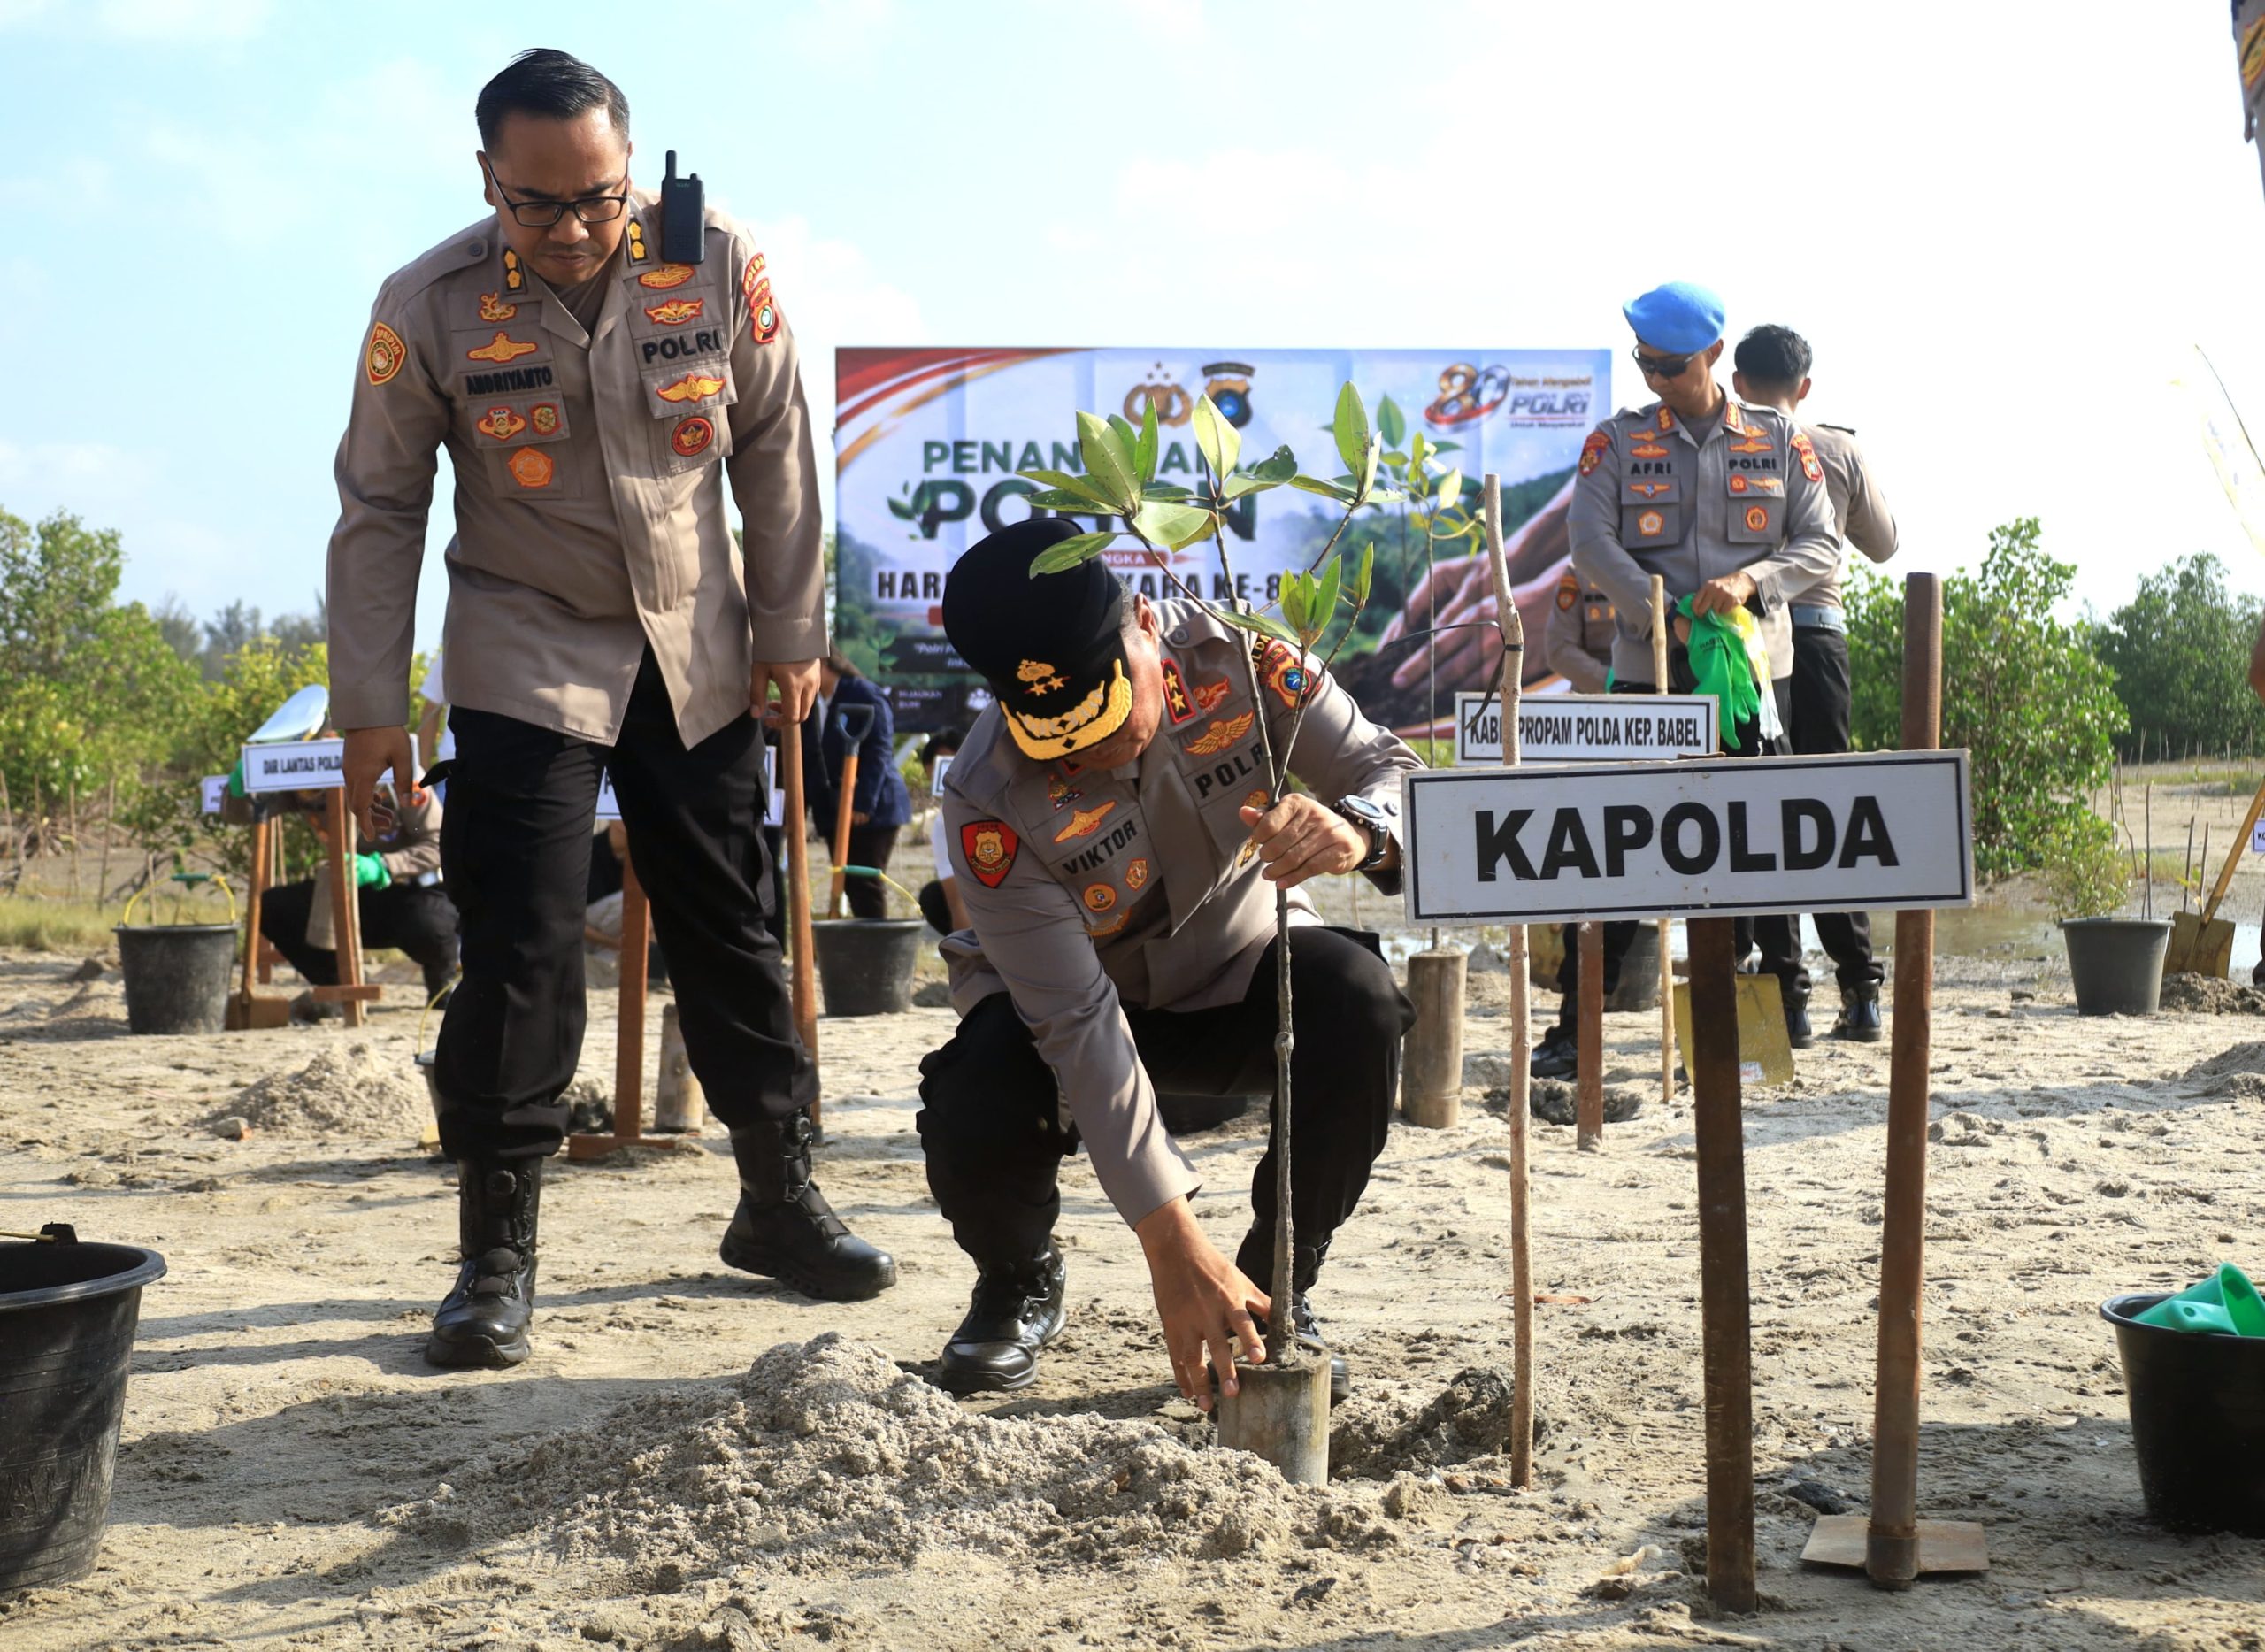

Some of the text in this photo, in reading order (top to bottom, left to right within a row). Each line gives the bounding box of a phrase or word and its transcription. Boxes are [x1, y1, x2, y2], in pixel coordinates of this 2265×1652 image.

[642, 329, 721, 365] POLRI
[465, 366, 553, 396] ANDRIYANTO
[1509, 392, 1590, 415] POLRI
[1631, 462, 1672, 475] AFRI
[1728, 458, 1777, 471] POLRI
[1577, 717, 1622, 746] POLDA
[1624, 718, 1653, 747] KEP.
[1657, 718, 1701, 748] BABEL
[1063, 818, 1139, 875] VIKTOR
[1474, 795, 1900, 883] KAPOLDA
